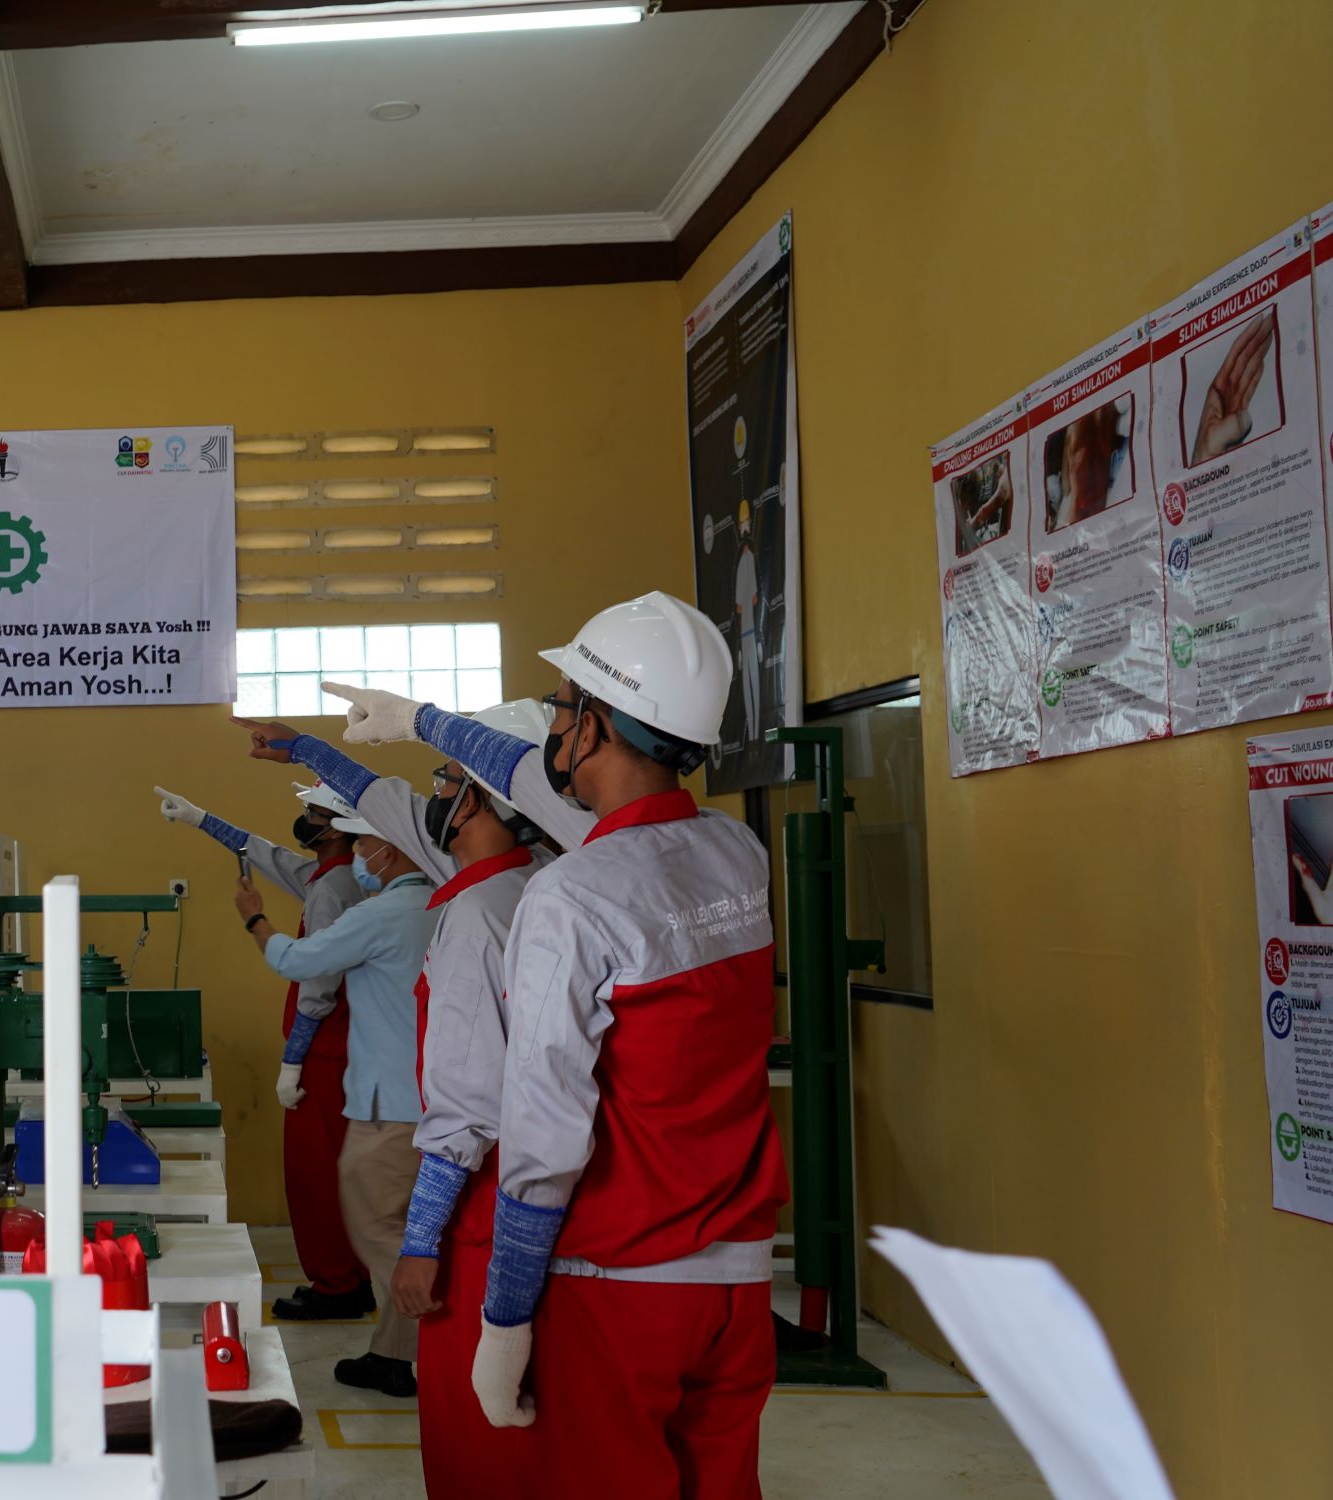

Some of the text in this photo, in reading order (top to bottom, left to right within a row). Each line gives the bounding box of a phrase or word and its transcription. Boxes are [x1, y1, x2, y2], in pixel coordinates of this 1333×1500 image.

[1179, 314, 1208, 343] SLINK
[1211, 274, 1278, 324] SIMULATION
[1053, 362, 1121, 413] HOT SIMULATION
[973, 426, 1014, 458] SIMULATION
[1183, 465, 1230, 492] BACKGROUND
[1188, 530, 1213, 548] TUJUAN
[42, 623, 102, 638] JAWAB
[105, 621, 152, 635] SAYA
[156, 620, 193, 633] Yosh
[196, 620, 211, 632] !!!
[1193, 617, 1240, 639] POINT SAFETY
[59, 646, 123, 670] Kerja
[132, 645, 180, 665] Kita
[589, 652, 612, 676] BERSAMA
[0, 676, 73, 697] Aman
[81, 674, 172, 695] Yosh...!
[1291, 740, 1323, 753] SIMULASI
[1266, 768, 1288, 784] CUT
[1291, 998, 1321, 1011] TUJUAN
[1300, 1124, 1324, 1138] POINT
